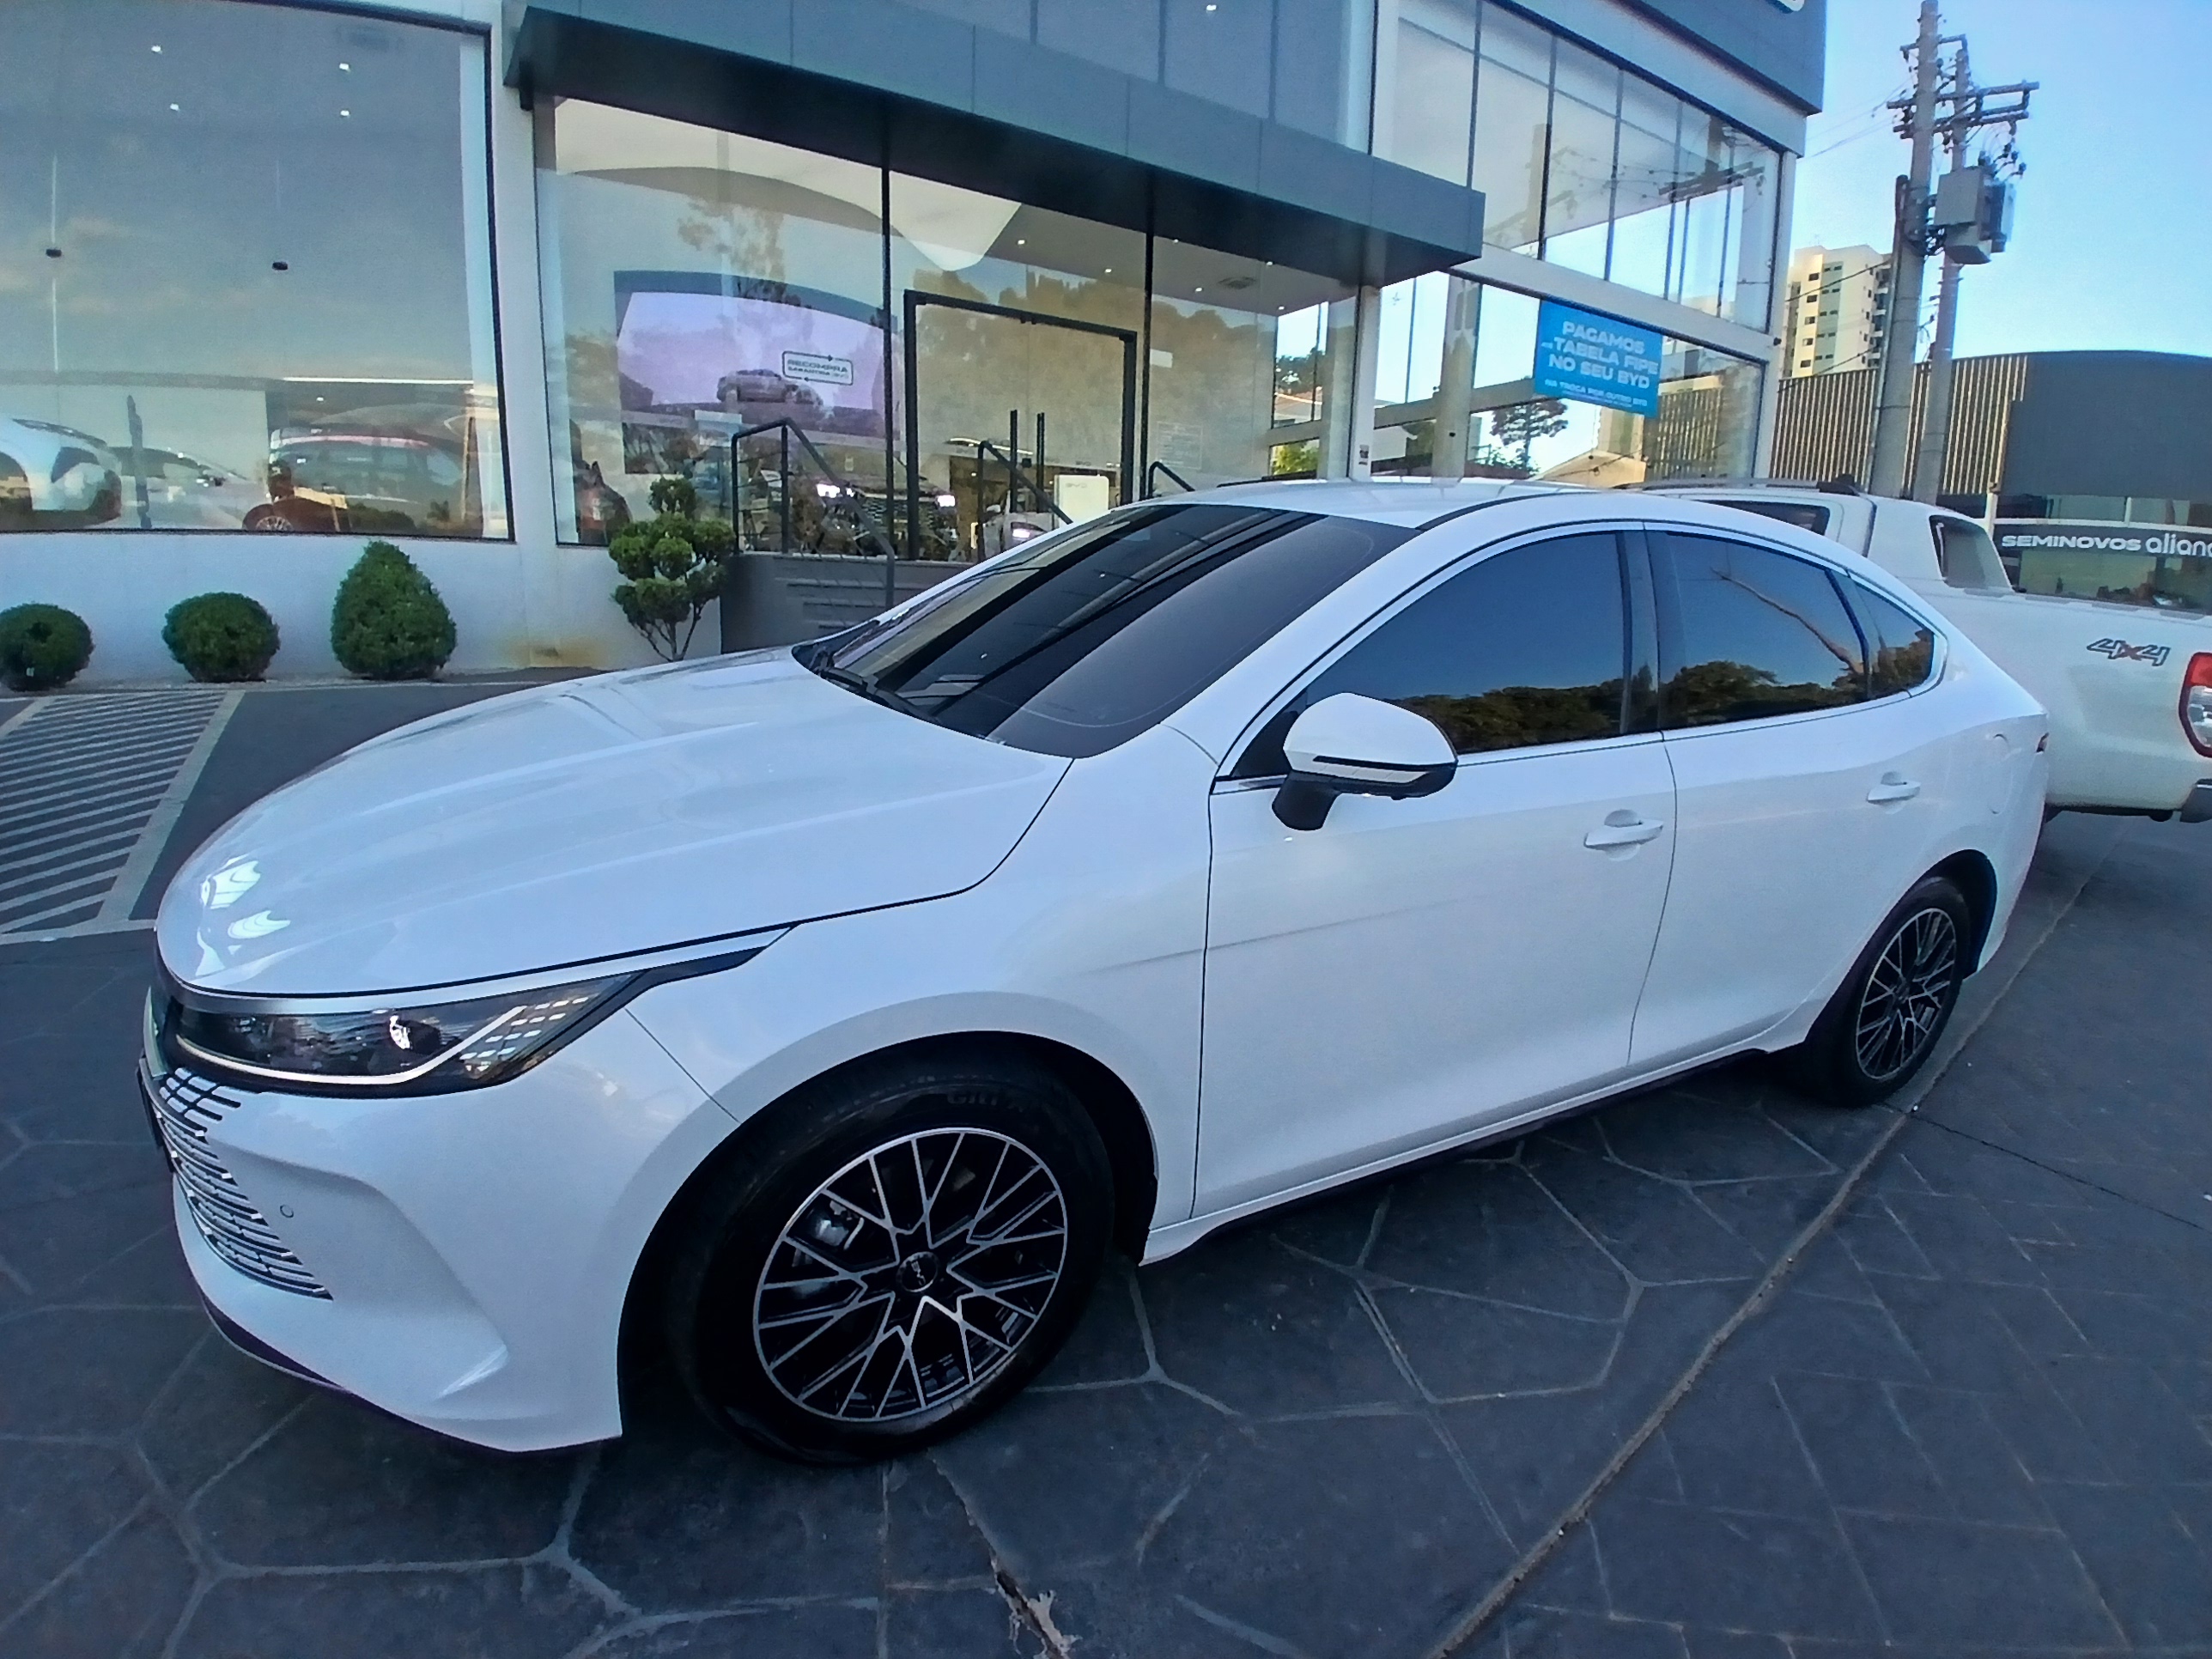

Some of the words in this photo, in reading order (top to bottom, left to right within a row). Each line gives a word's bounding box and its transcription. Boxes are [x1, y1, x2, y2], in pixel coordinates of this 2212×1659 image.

[1562, 320, 1645, 355] PAGAMOS
[787, 359, 848, 373] RECOMPRA
[1548, 354, 1576, 372] NO
[1580, 361, 1613, 380] SEU
[1617, 370, 1650, 389] BYD
[1553, 337, 1620, 366] TABELA
[1624, 355, 1659, 375] FIPE
[2002, 535, 2142, 551] SEMINOVOS
